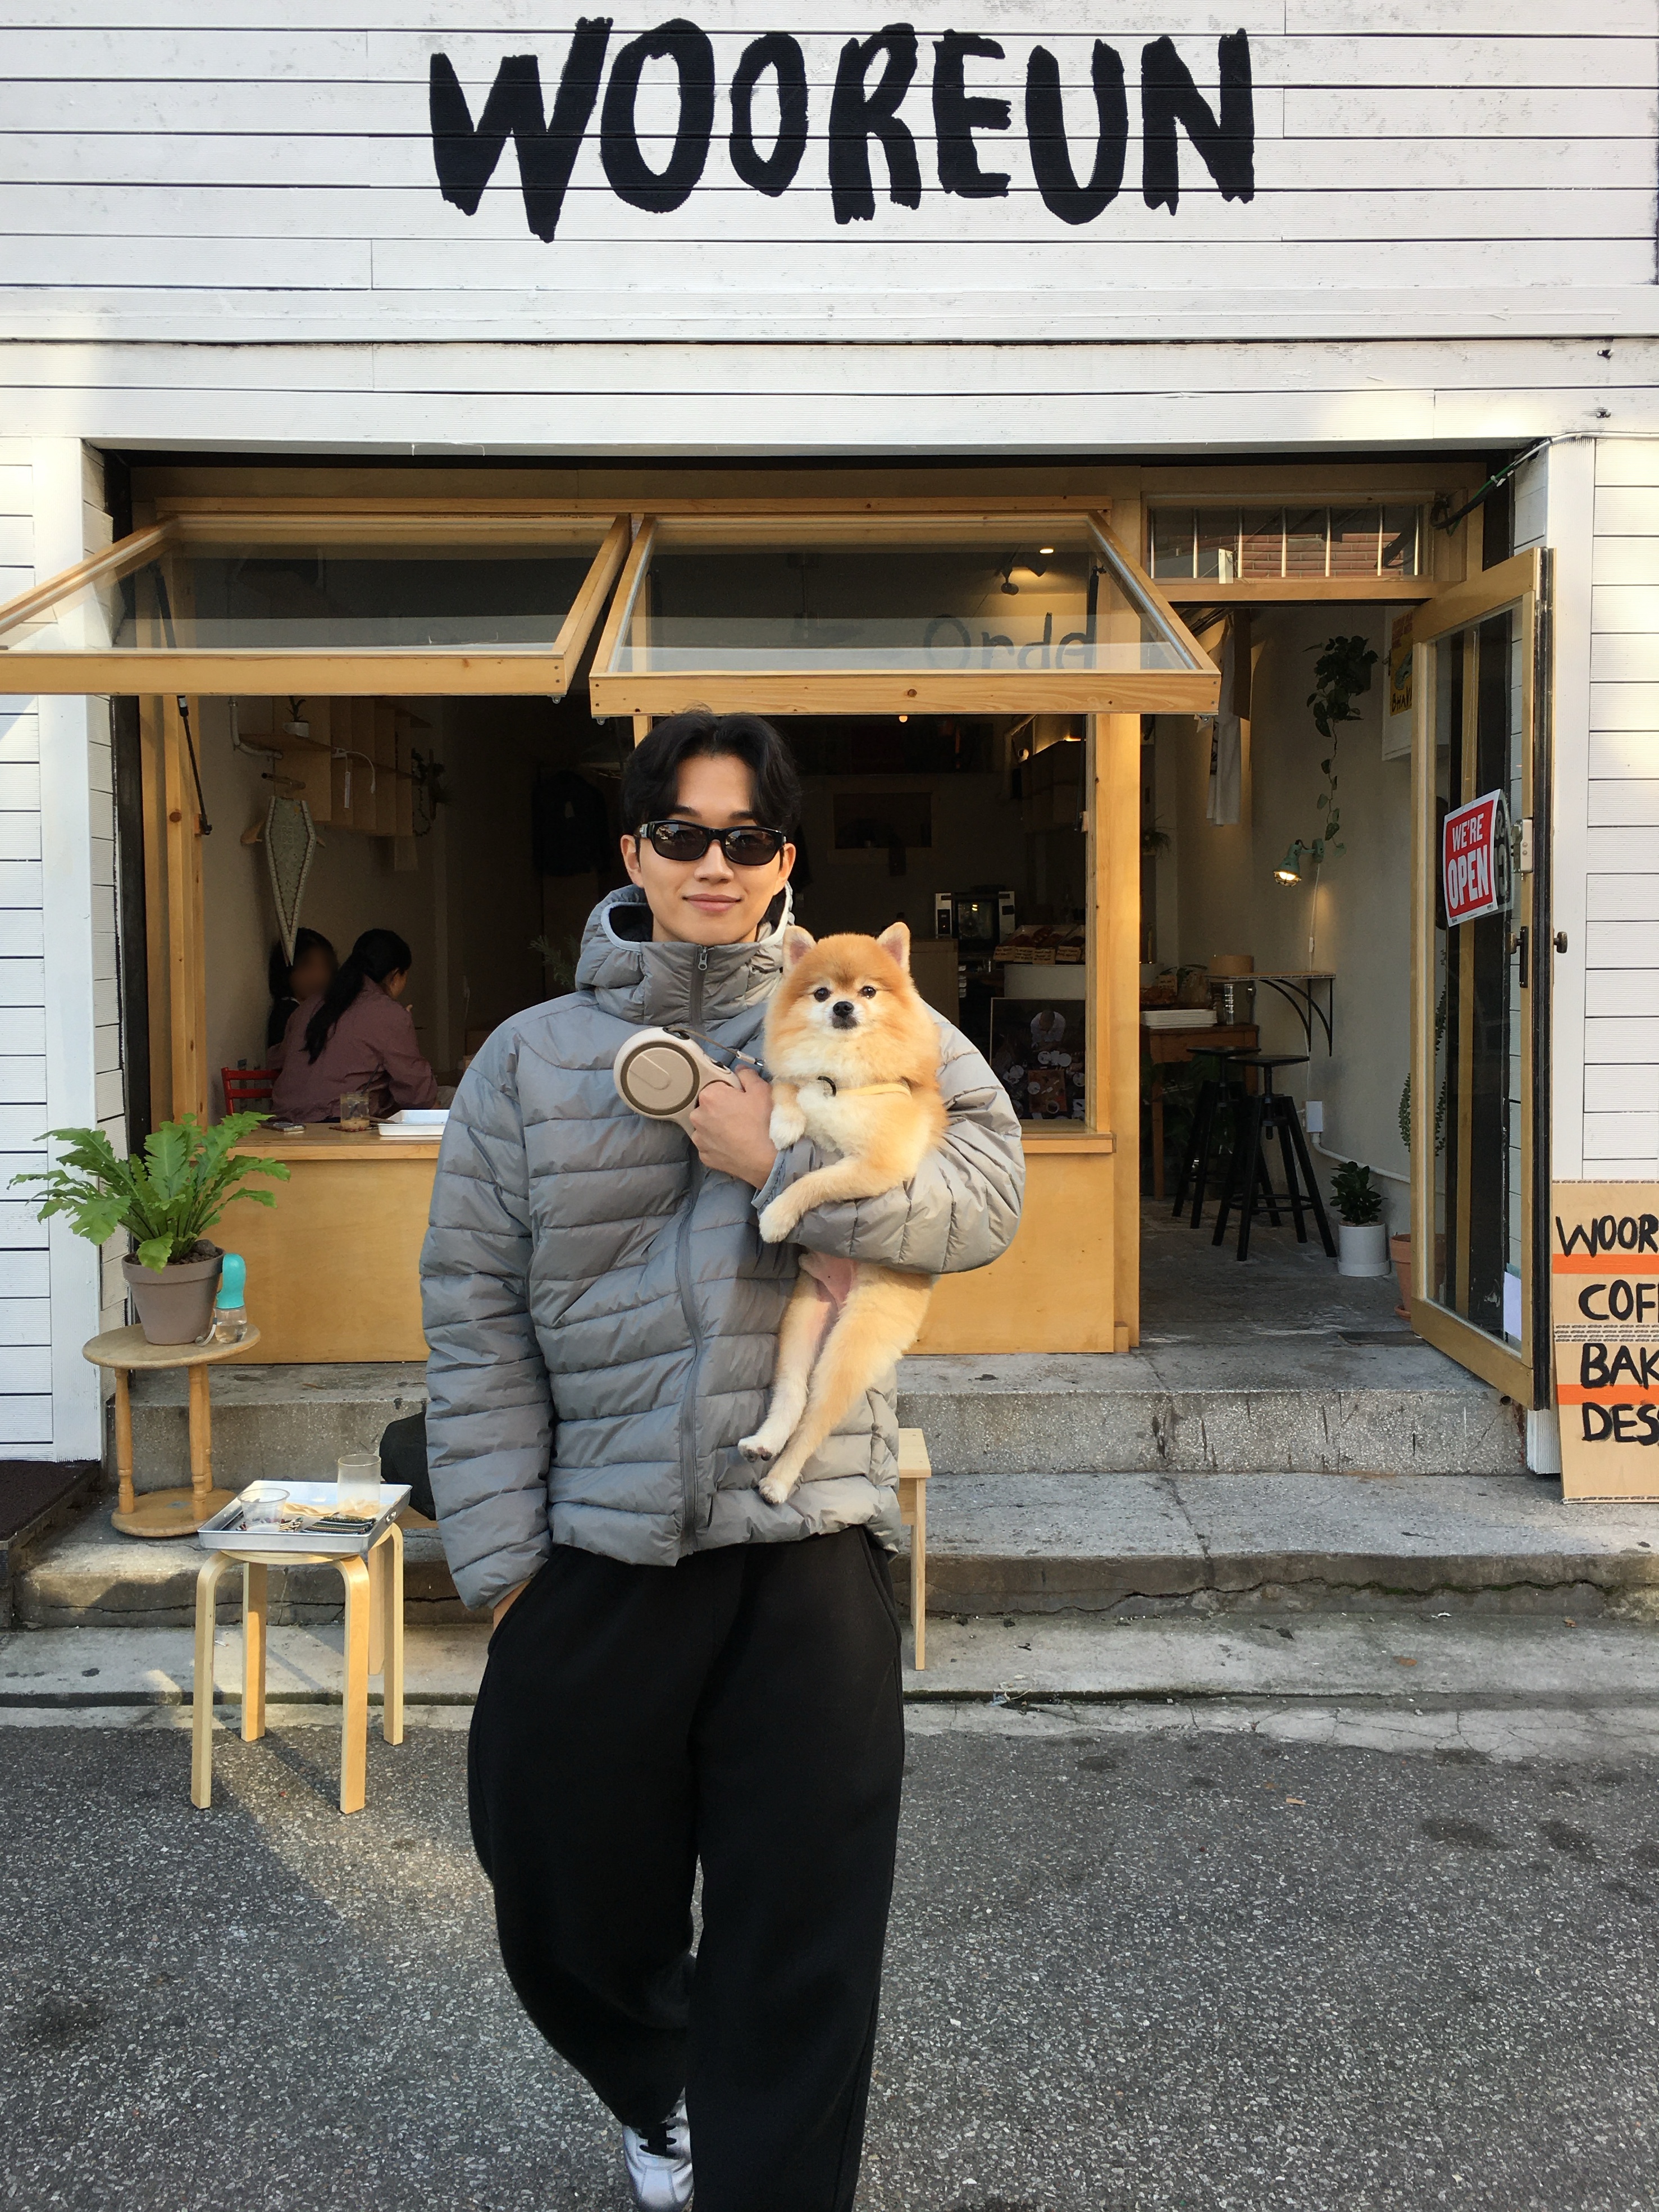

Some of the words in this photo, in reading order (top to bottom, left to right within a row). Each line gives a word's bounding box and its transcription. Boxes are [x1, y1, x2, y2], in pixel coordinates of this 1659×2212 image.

[430, 17, 1255, 243] WOOREUN
[1452, 813, 1484, 852] WE'RE
[1448, 844, 1489, 909] OPEN
[1555, 1214, 1659, 1258] WOOR
[1579, 1279, 1659, 1323] COF
[1580, 1342, 1659, 1390] BAK
[1581, 1401, 1659, 1446] DES
